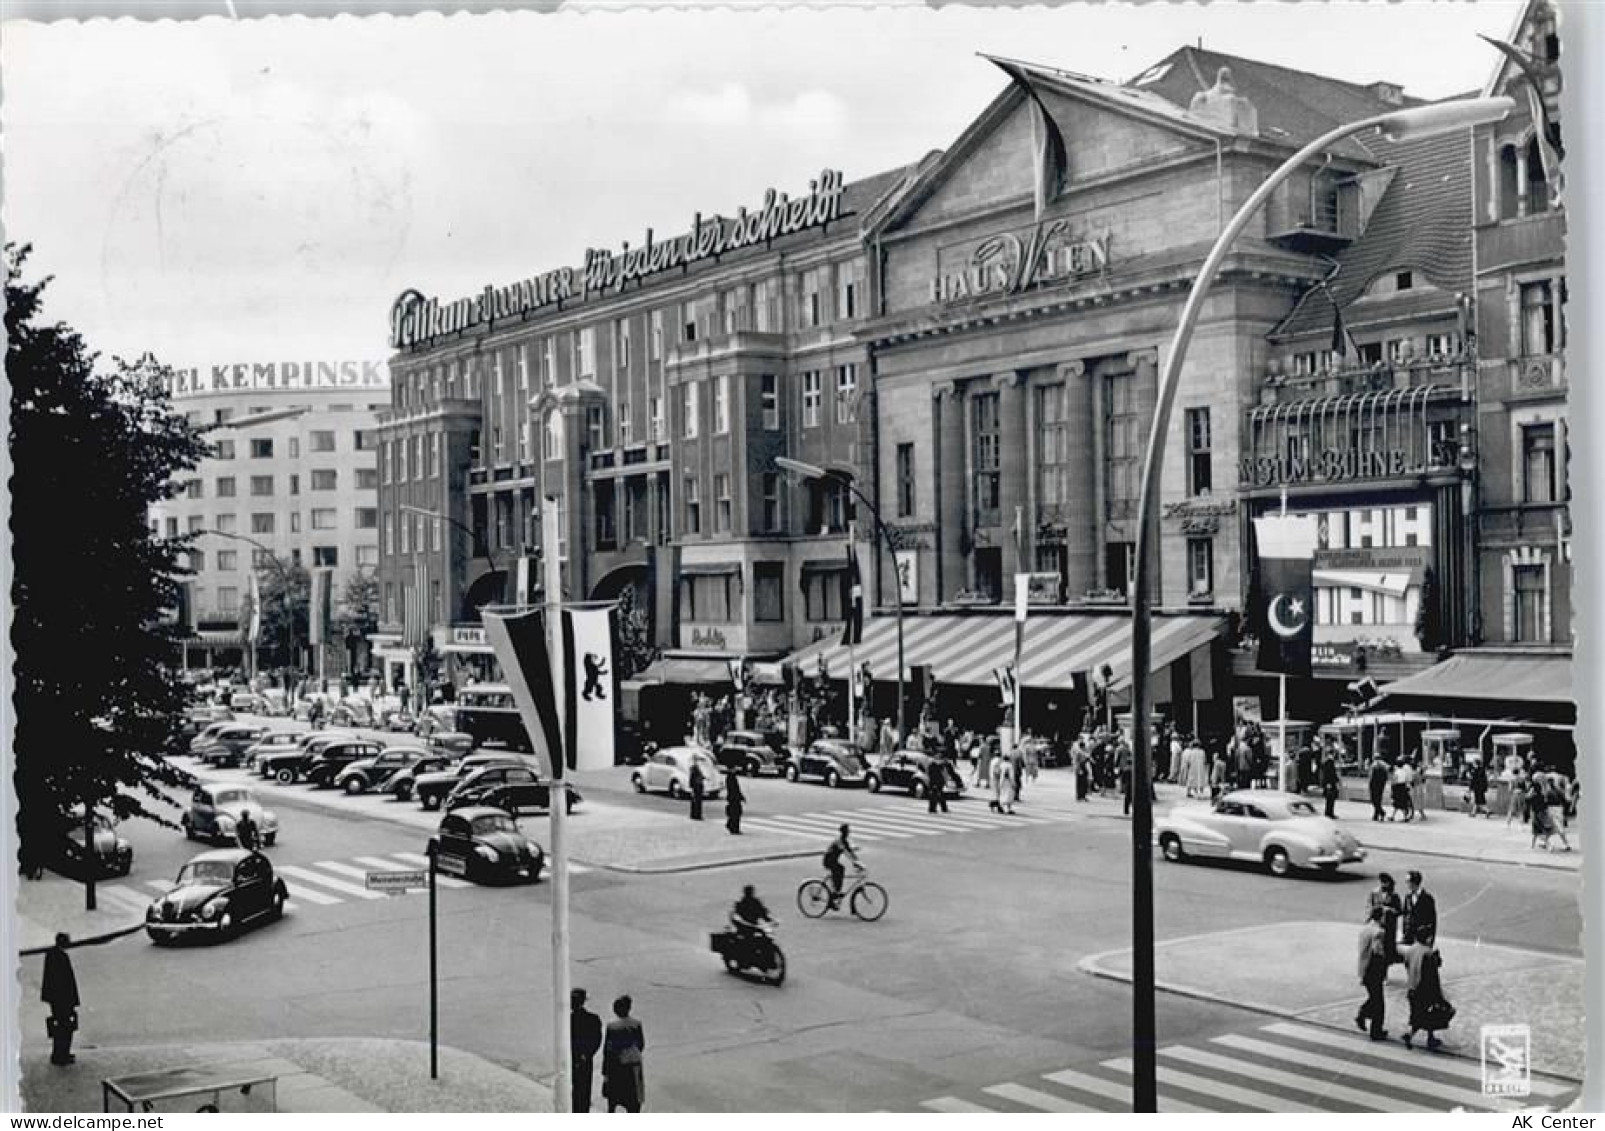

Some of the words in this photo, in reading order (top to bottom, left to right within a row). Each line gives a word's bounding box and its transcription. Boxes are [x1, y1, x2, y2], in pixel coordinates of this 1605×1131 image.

[475, 267, 573, 326] FÜLLHALTER
[583, 247, 616, 297] für
[615, 228, 681, 293] jeden
[685, 211, 724, 255] der
[727, 169, 847, 249] schreibt
[929, 260, 1010, 302] HAUS
[972, 218, 1113, 293] WIEN
[162, 366, 206, 398] TEL
[211, 360, 386, 390] KEMPINSK
